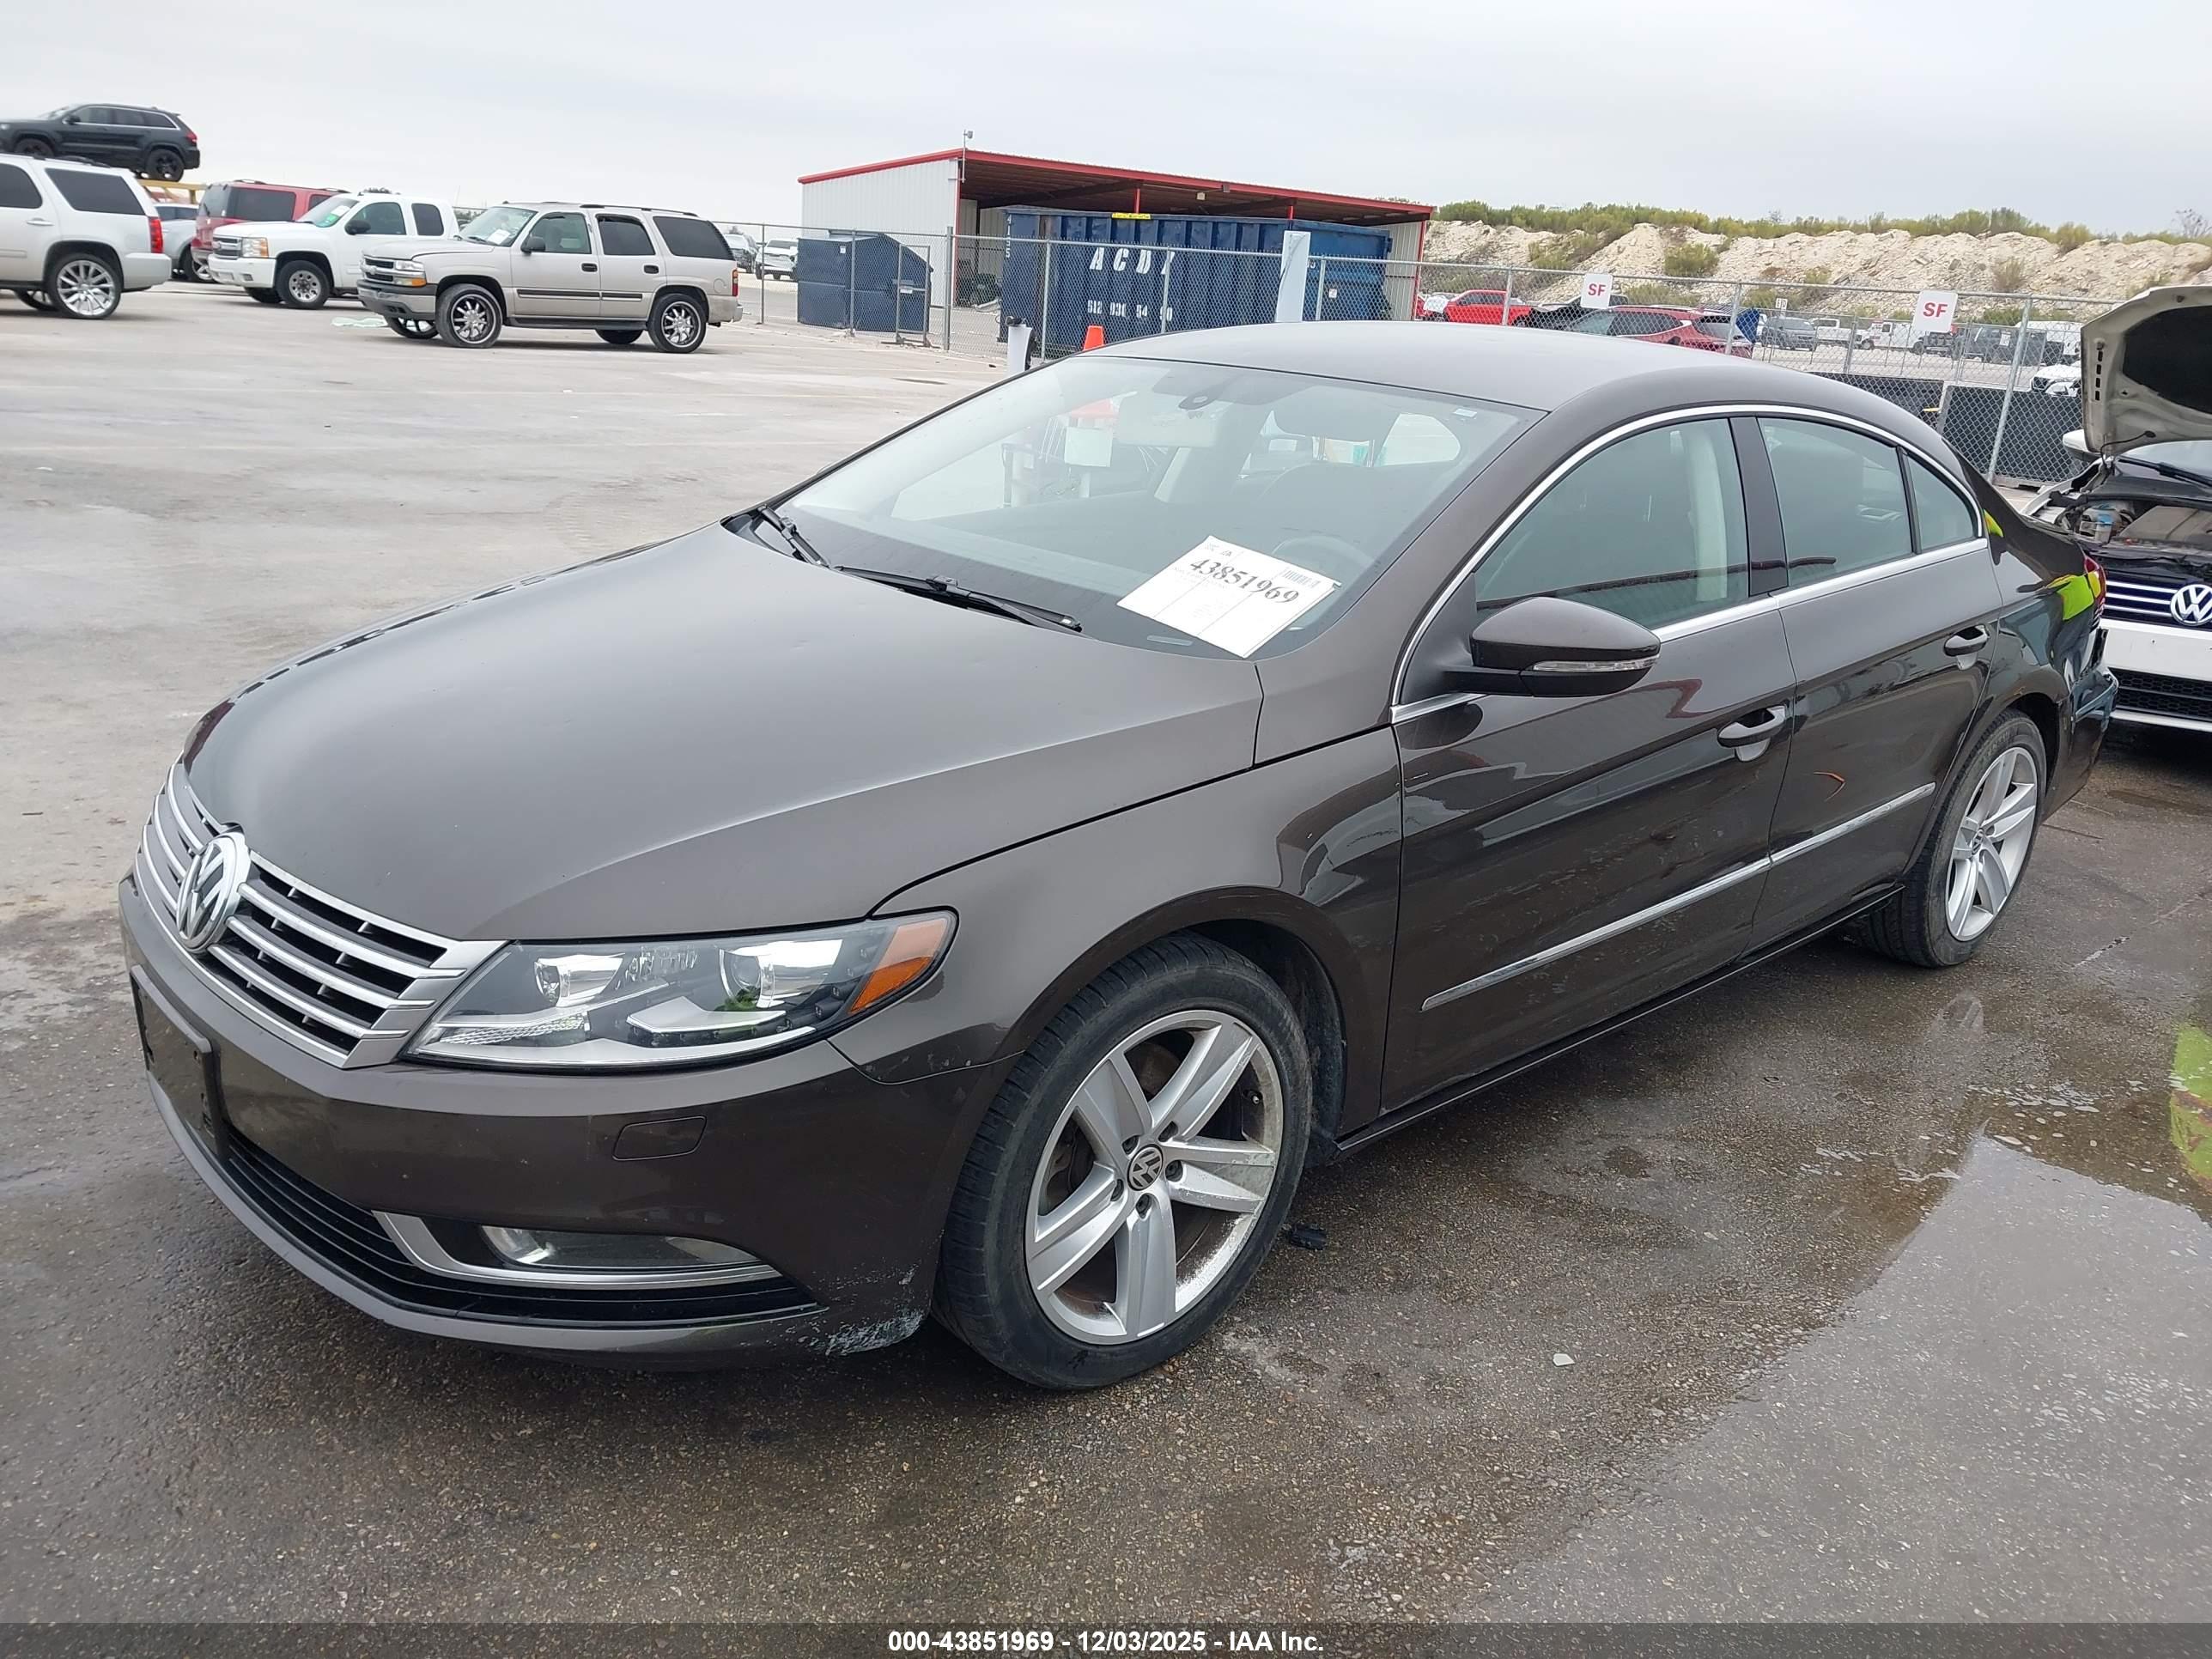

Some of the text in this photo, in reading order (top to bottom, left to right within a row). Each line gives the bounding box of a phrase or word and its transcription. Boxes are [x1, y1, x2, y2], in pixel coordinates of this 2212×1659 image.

[1588, 283, 1607, 296] SF
[1923, 301, 1948, 318] SF
[1190, 559, 1299, 603] 43851969
